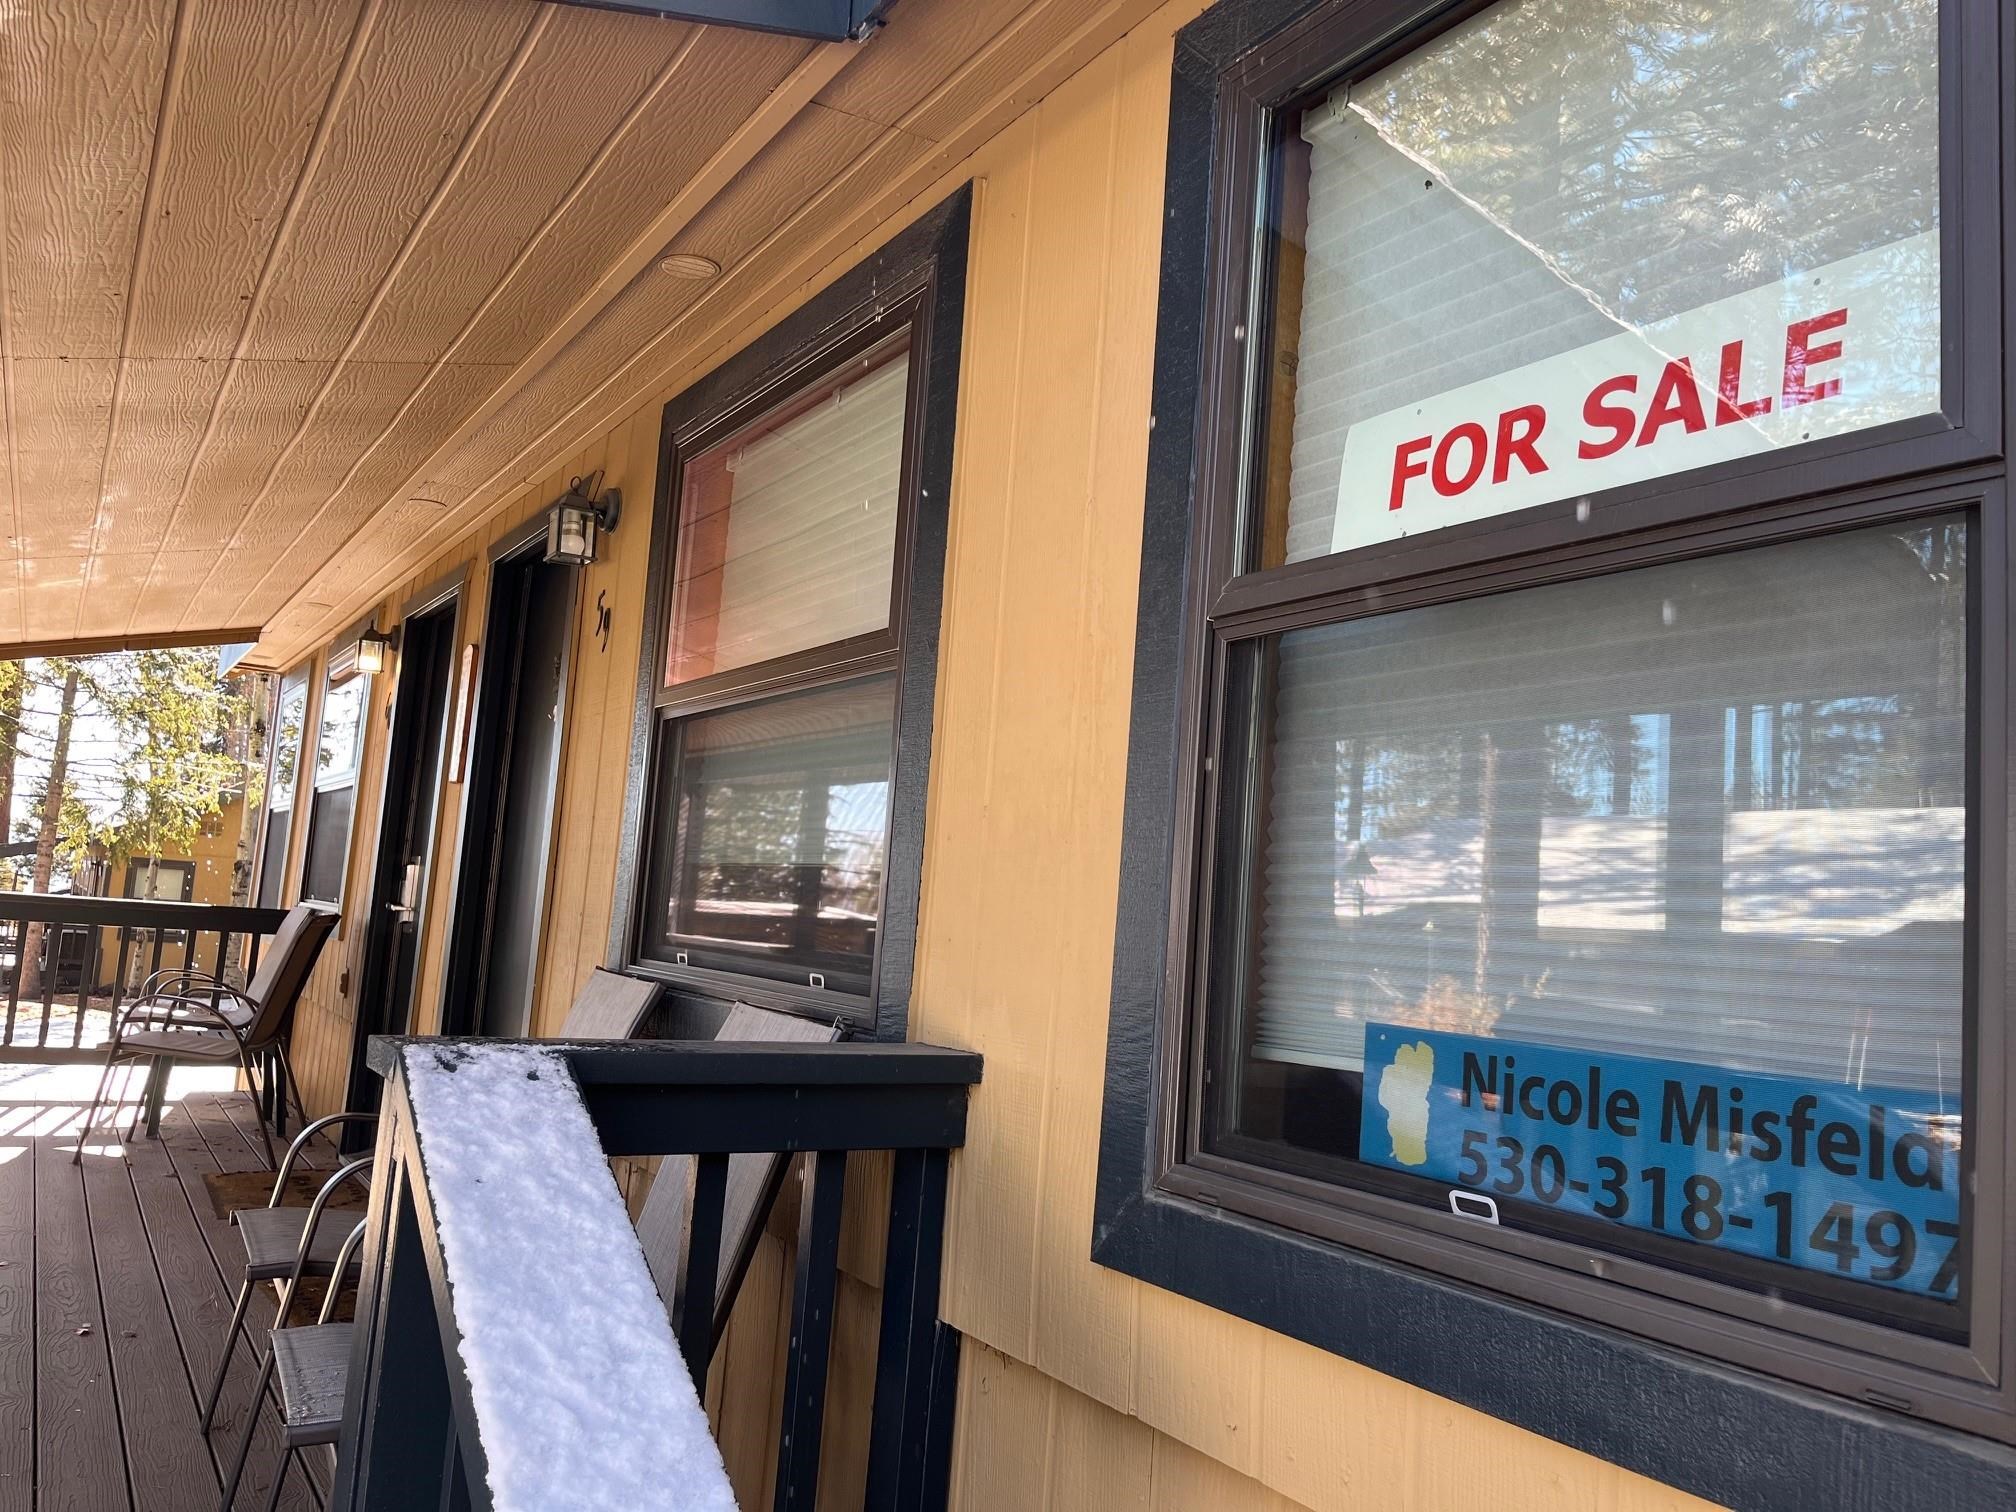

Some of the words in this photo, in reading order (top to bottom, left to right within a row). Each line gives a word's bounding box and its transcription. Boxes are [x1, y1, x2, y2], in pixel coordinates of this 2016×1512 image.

[1389, 403, 1549, 512] FOR
[1577, 307, 1848, 460] SALE
[1460, 1051, 1640, 1137] Nicole
[1659, 1079, 1944, 1192] Misfeld
[1457, 1129, 1960, 1294] 530-318-1497
